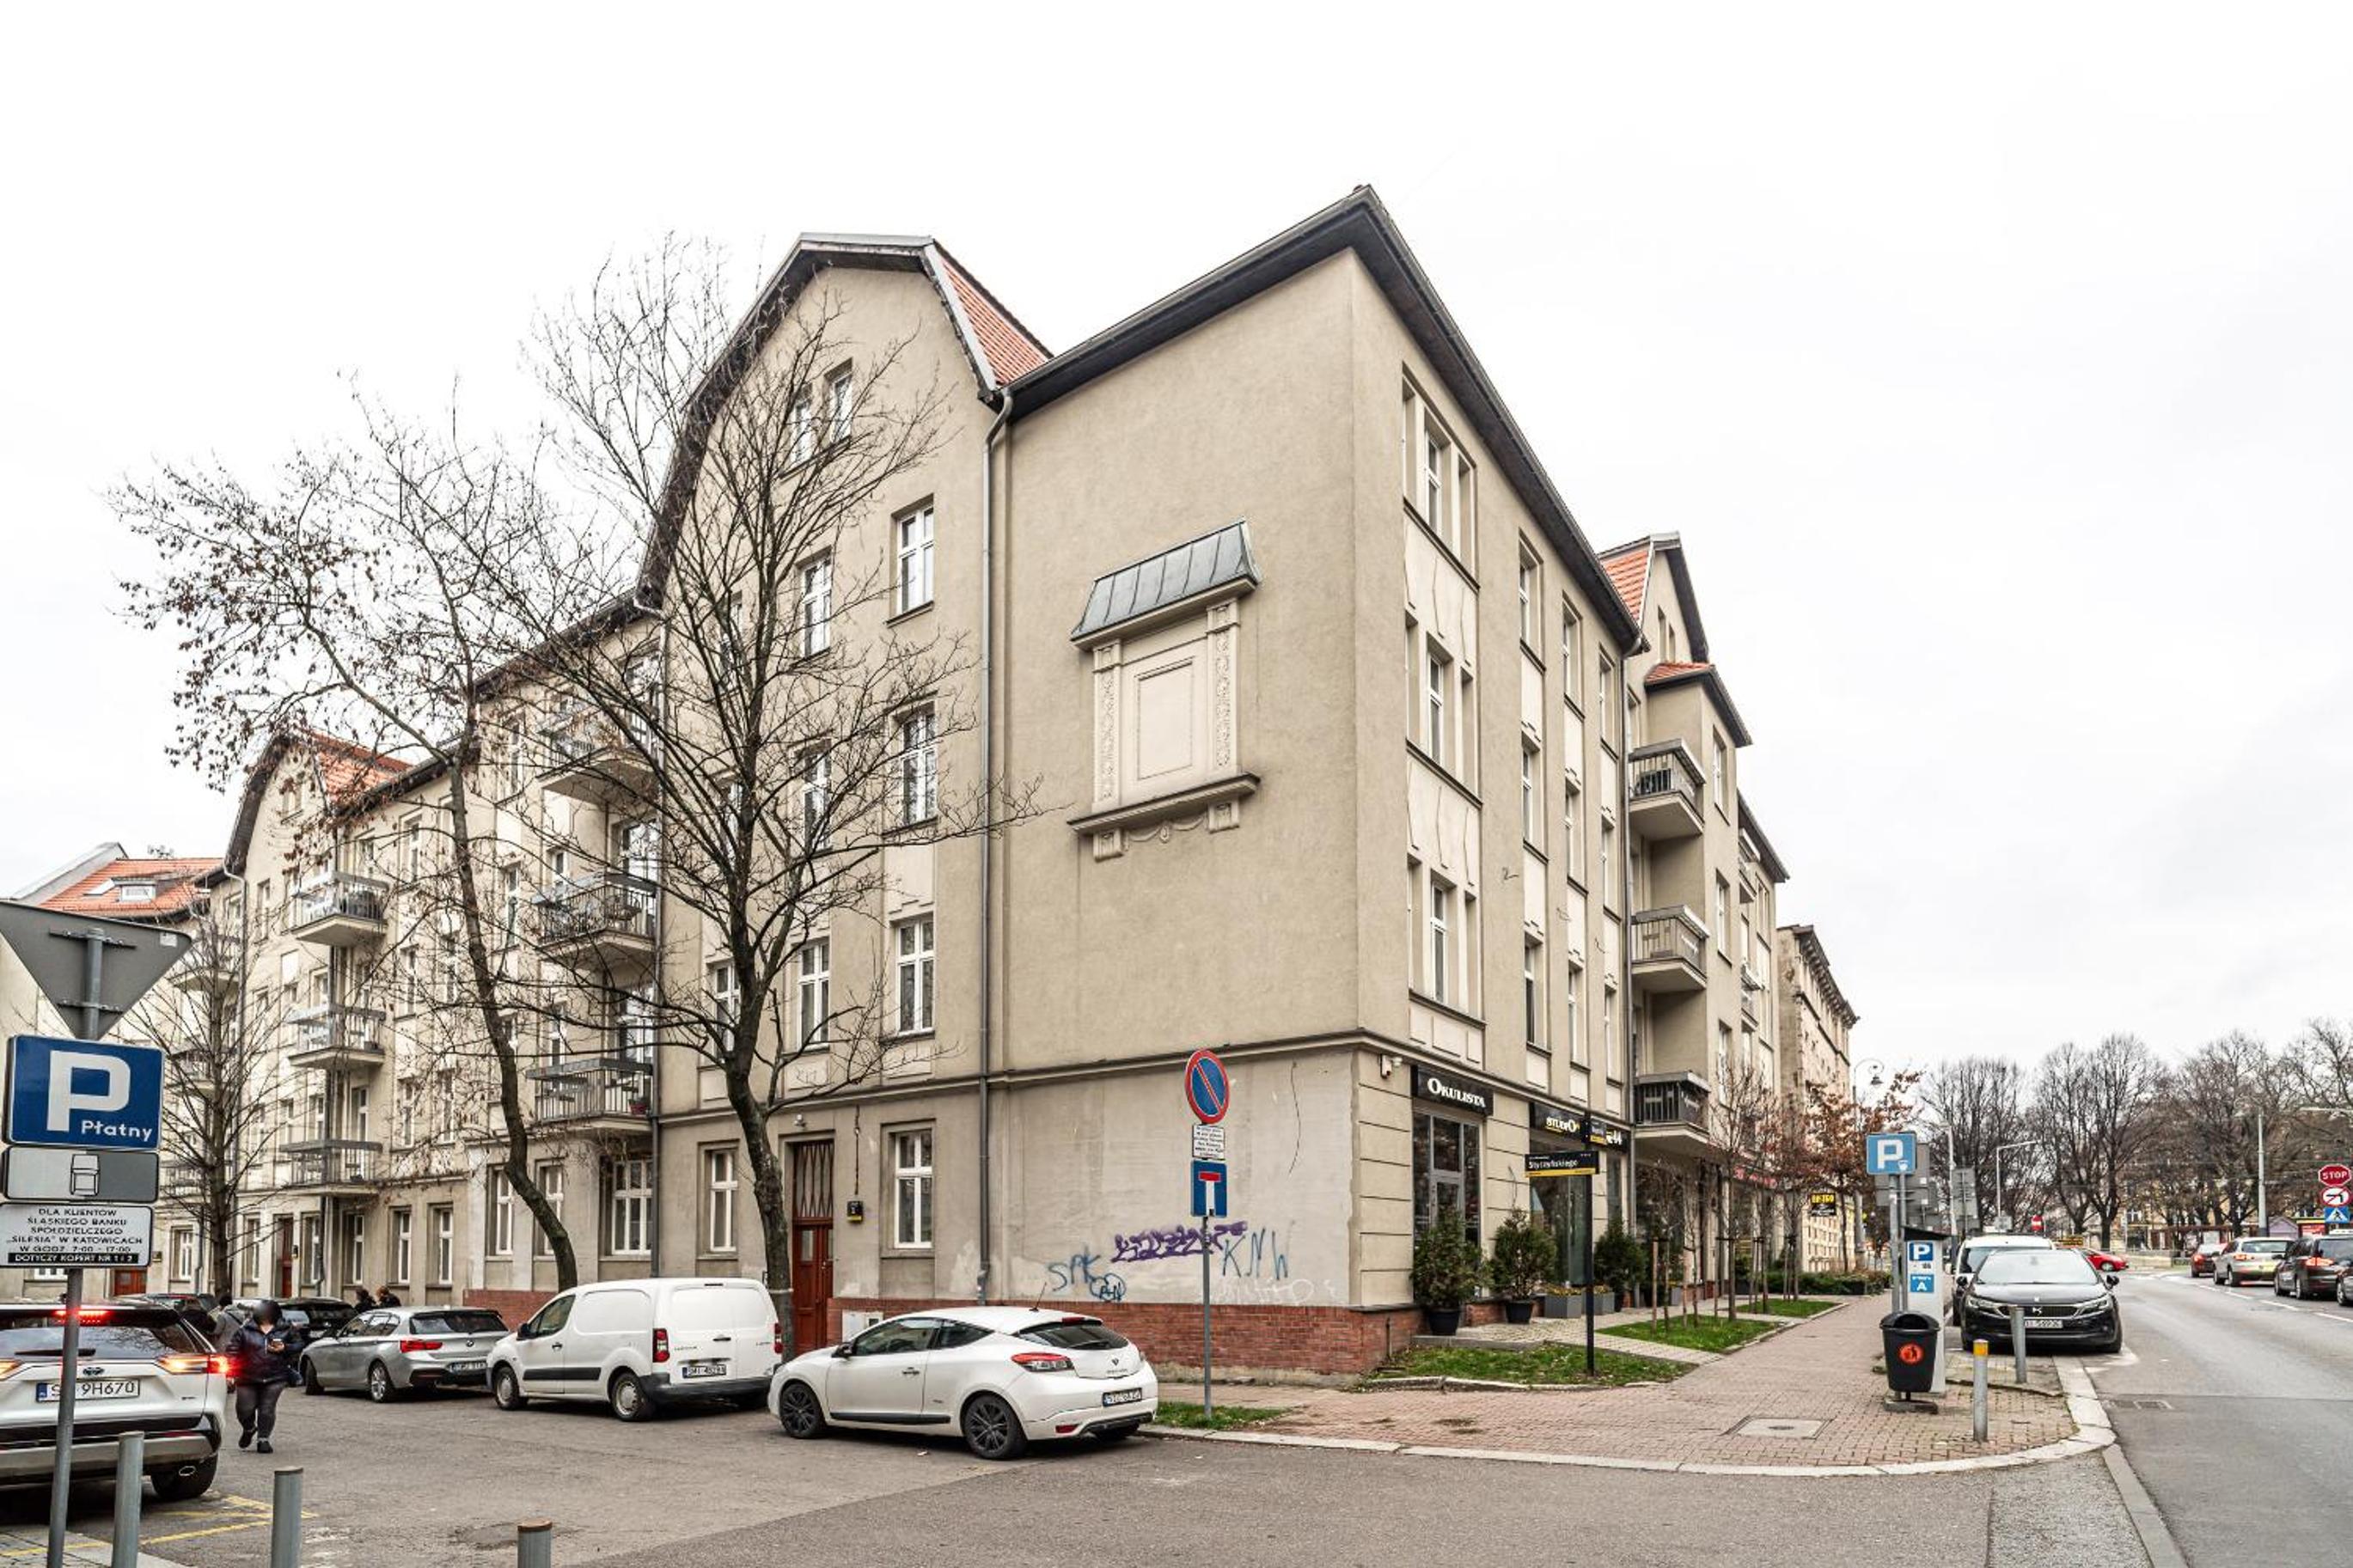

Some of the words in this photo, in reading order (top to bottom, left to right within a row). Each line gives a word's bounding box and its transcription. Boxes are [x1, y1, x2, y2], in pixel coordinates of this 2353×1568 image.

[46, 1050, 131, 1132] P
[81, 1120, 153, 1142] Płatny
[1877, 1139, 1904, 1169] P
[2322, 1171, 2348, 1180] STOP
[1913, 1244, 1931, 1260] P
